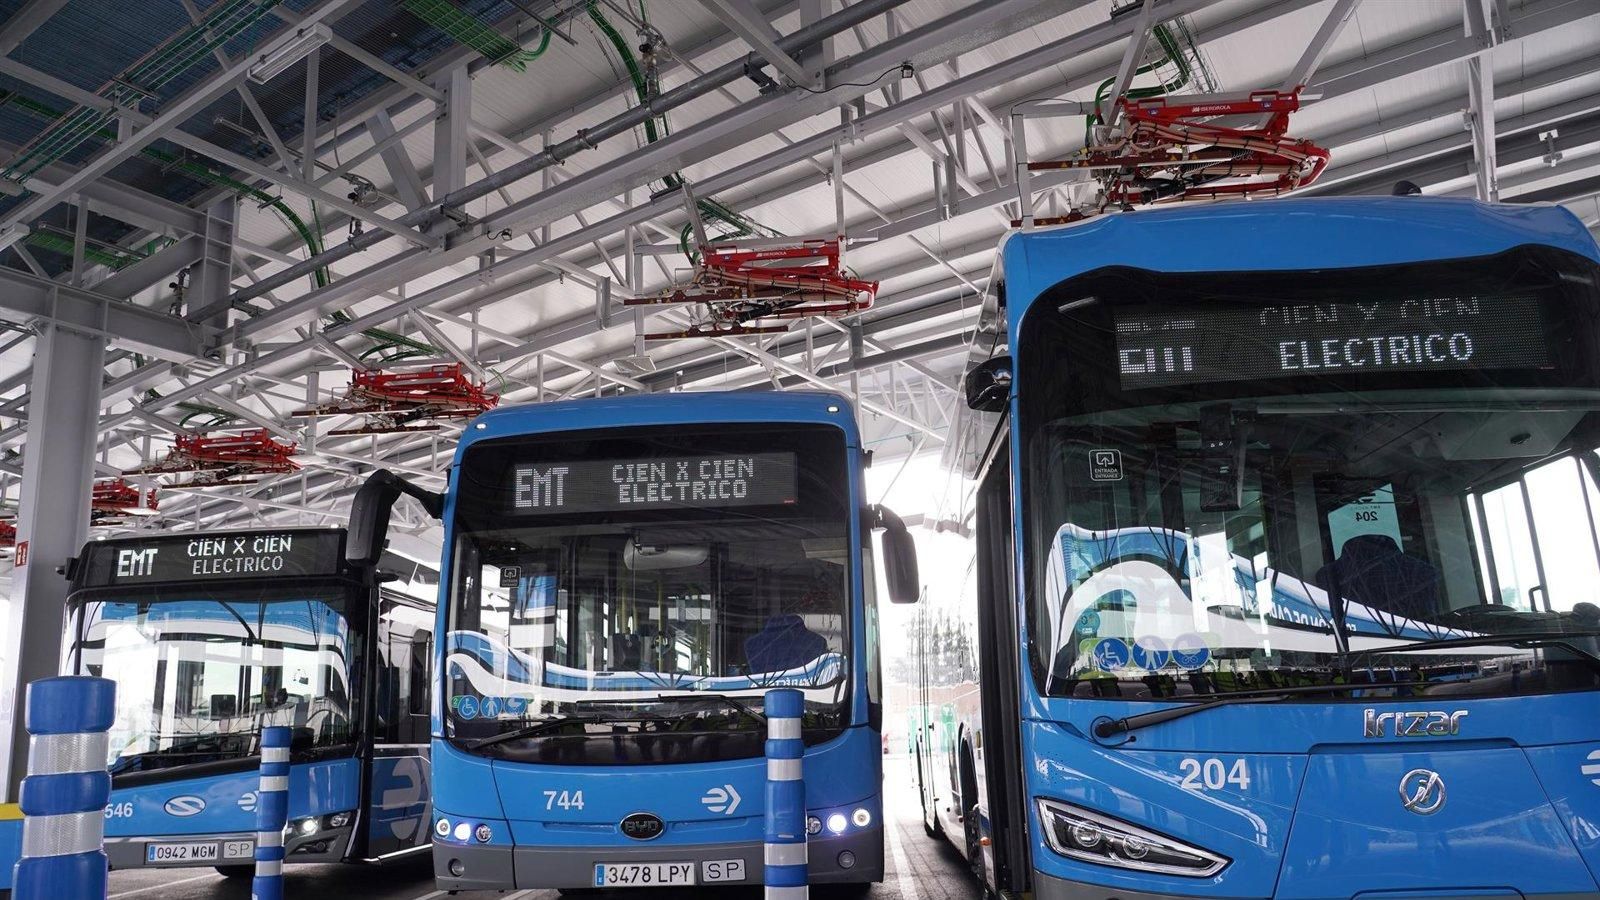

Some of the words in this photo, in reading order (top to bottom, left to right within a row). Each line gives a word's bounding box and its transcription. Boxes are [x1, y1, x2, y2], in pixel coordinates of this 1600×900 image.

[1279, 333, 1473, 369] ELECTRICO
[612, 463, 666, 483] CIEN
[676, 461, 688, 480] X
[699, 458, 753, 479] CIEN
[515, 467, 569, 507] EMT
[619, 480, 747, 503] ELECTRICO
[187, 537, 227, 557] CIEN
[233, 536, 246, 555] X
[253, 534, 292, 554] CIEN
[117, 549, 158, 577] EMT
[192, 555, 283, 575] ELECTRICO
[1363, 709, 1468, 737] Irizar
[1179, 758, 1250, 790] 204
[543, 790, 585, 810] 744
[624, 820, 659, 832] BYD
[157, 847, 187, 859] 0942
[191, 846, 216, 858] MGM
[228, 844, 250, 856] SP
[608, 866, 651, 884] 3478
[658, 865, 690, 883] LPY
